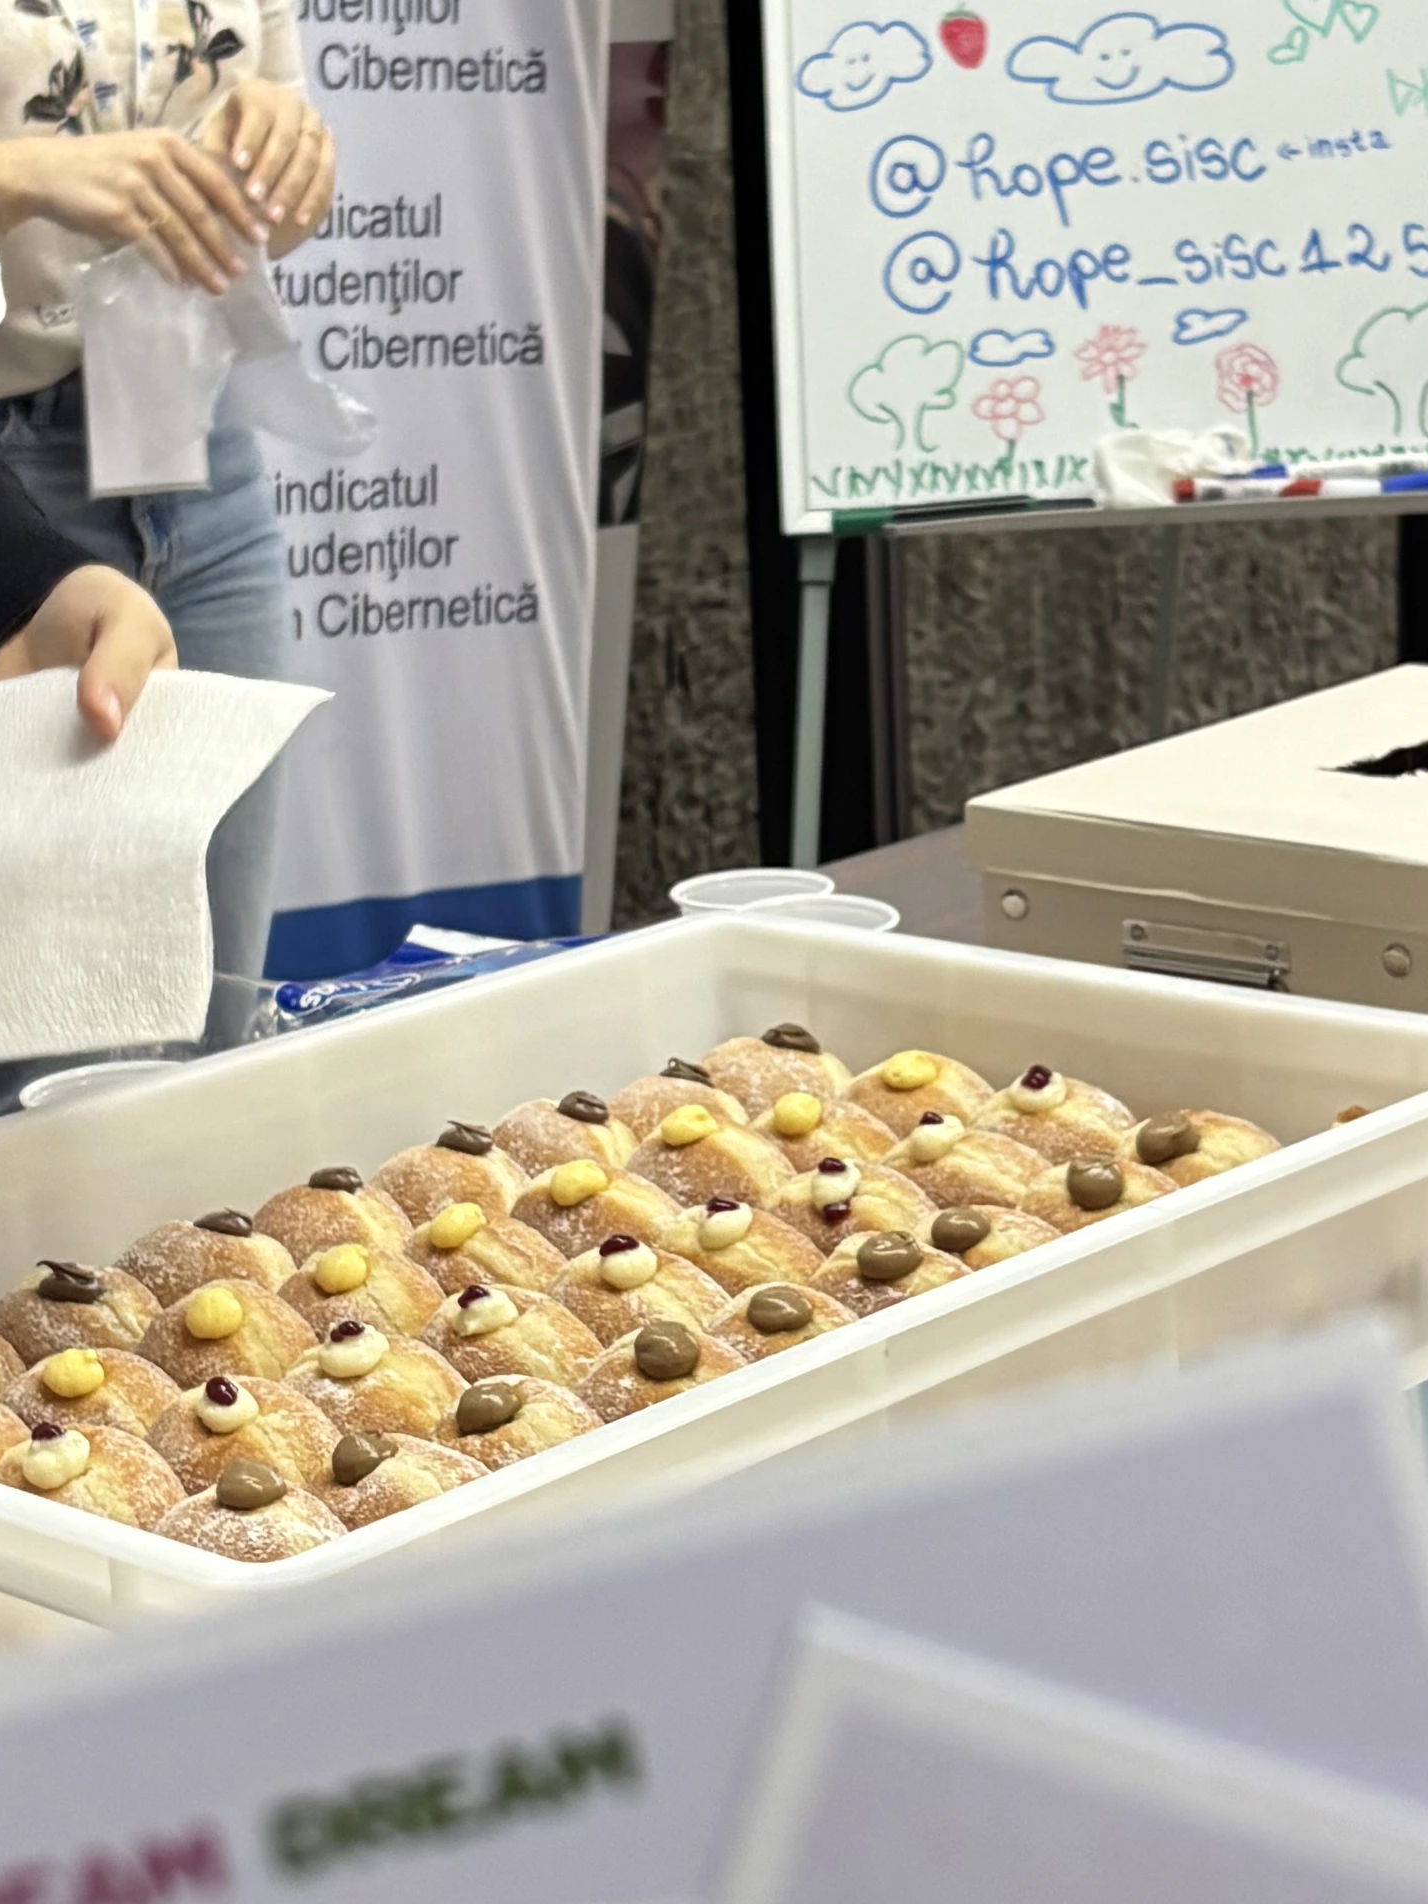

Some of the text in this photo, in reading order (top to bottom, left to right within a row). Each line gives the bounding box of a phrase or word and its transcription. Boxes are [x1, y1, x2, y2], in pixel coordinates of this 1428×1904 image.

[319, 43, 547, 93] Cibernetică
[319, 324, 544, 371] Cibernetică
[275, 464, 438, 515] indicatul
[317, 582, 538, 638] Cibernetică
[260, 1718, 645, 1885] DREAM
